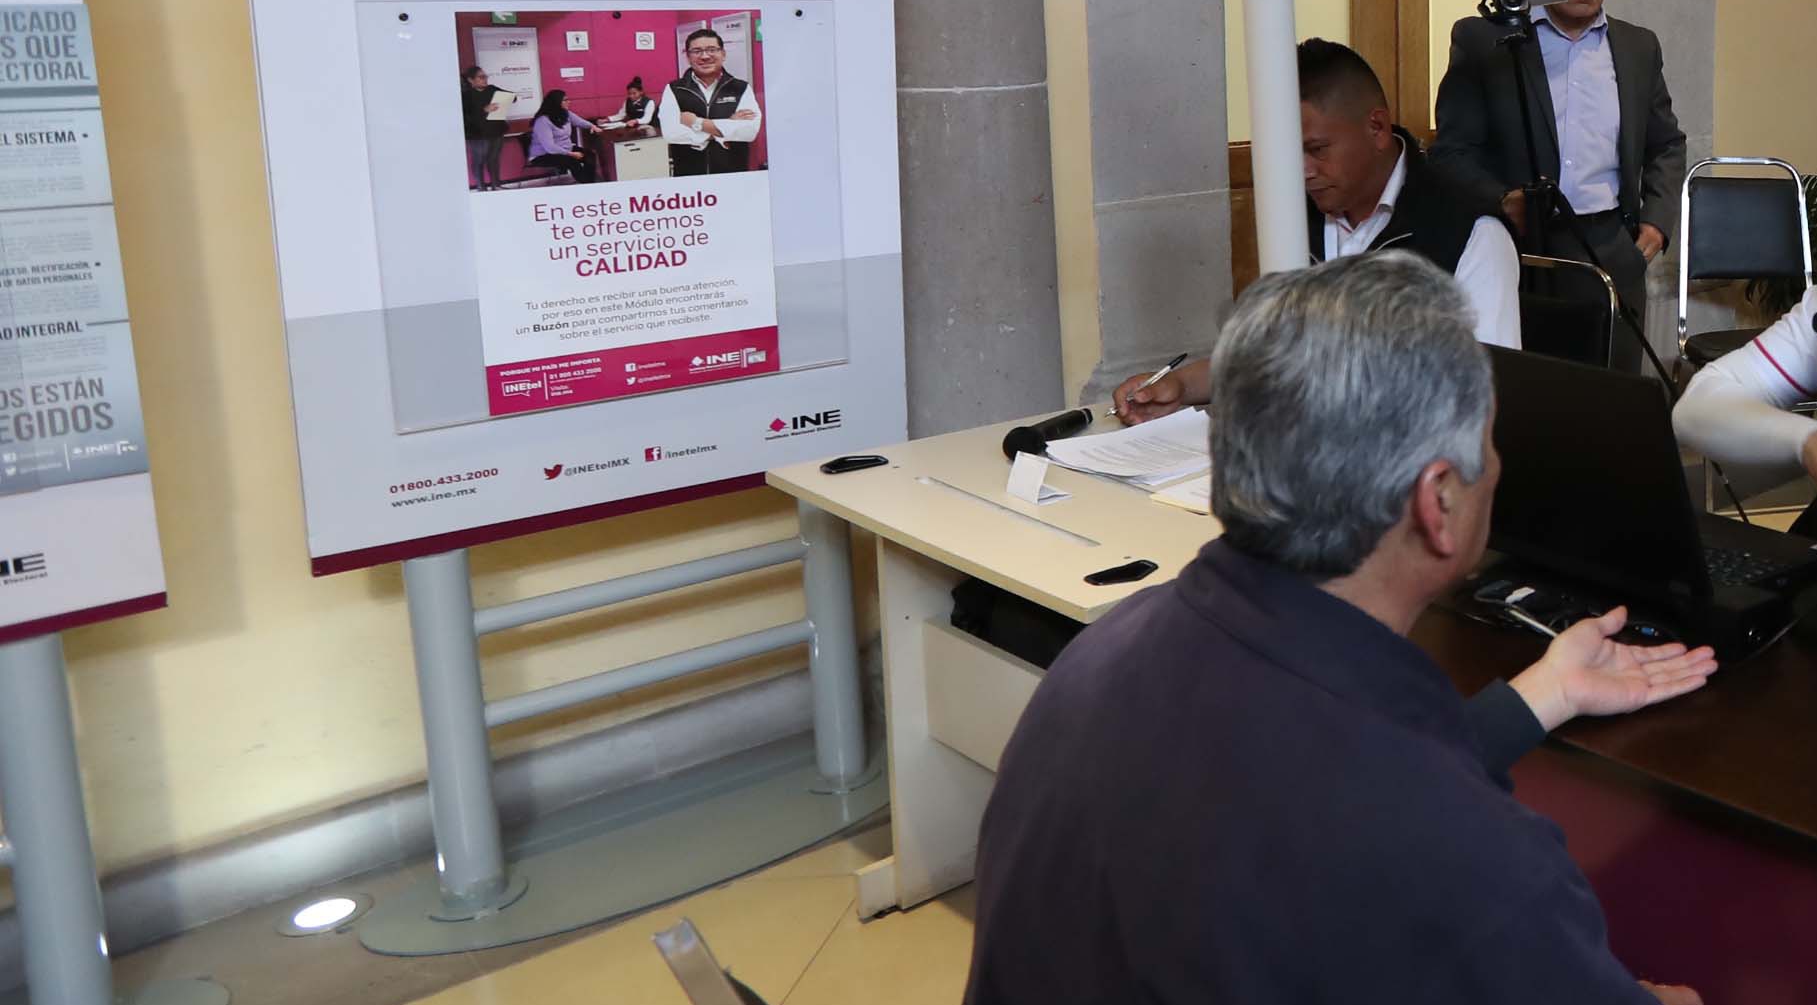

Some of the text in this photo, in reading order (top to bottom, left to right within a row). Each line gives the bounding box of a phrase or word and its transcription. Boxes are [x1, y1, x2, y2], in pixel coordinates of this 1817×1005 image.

[3, 11, 77, 32] ICADO
[25, 35, 79, 60] QUE
[15, 130, 77, 146] SISTEMA
[533, 191, 718, 222] En este Módulo
[551, 212, 705, 241] te ofrecemos
[549, 229, 710, 261] un servicio de
[575, 249, 688, 277] CALIDAD
[525, 301, 539, 311] Tu
[540, 296, 586, 310] derecho
[638, 289, 658, 298] una
[659, 284, 691, 295] buena
[541, 312, 560, 322] por
[563, 309, 583, 318] eso
[584, 306, 598, 315] en
[600, 302, 623, 313] este
[624, 297, 664, 309] Módulo
[16, 319, 83, 338] INTEGRAL
[515, 326, 530, 335] un
[532, 321, 570, 333] Buzón
[571, 317, 596, 329] para
[559, 329, 590, 341] sobre
[591, 327, 601, 336] el
[603, 323, 644, 335] servicio
[646, 320, 666, 330] que
[706, 351, 740, 365] INE
[30, 377, 105, 406] ESTÁN
[792, 408, 841, 430] INE
[389, 467, 499, 494] 01800.433.2000
[391, 486, 478, 508] www.ine.mx
